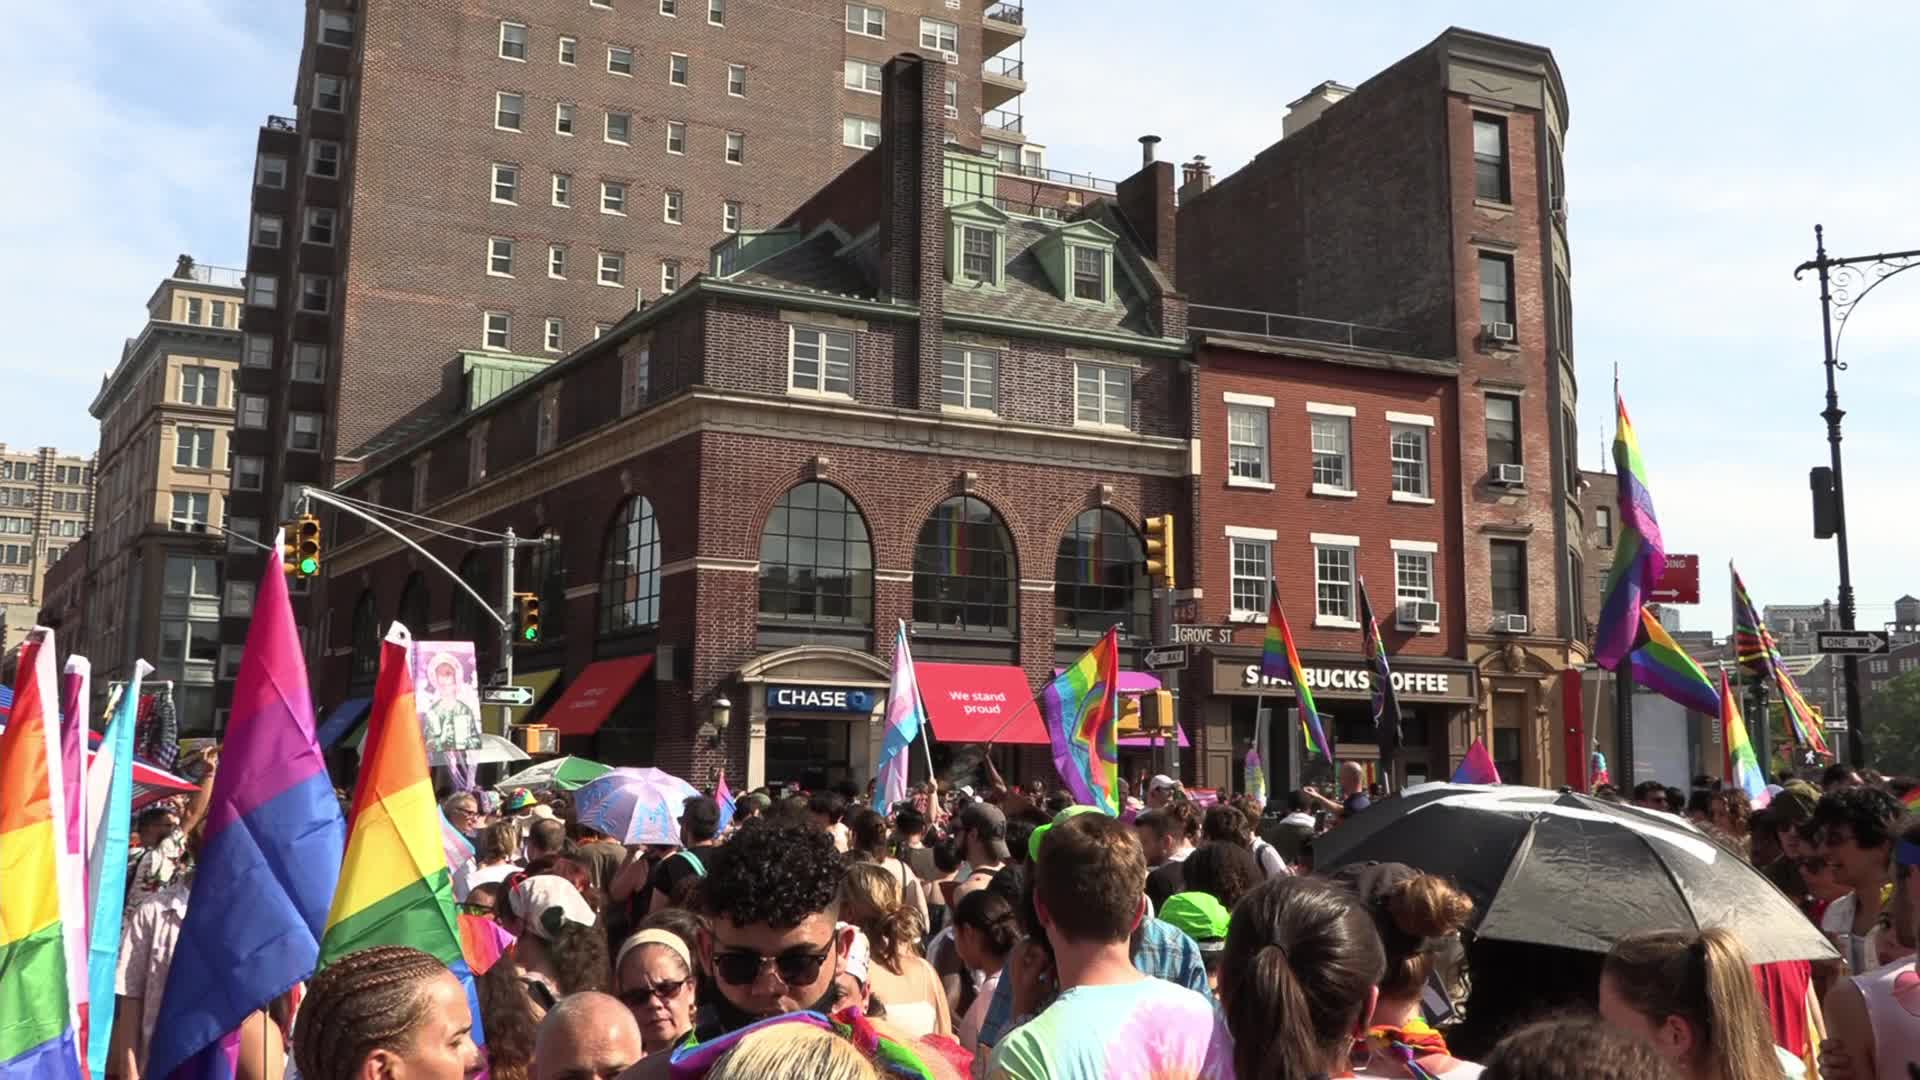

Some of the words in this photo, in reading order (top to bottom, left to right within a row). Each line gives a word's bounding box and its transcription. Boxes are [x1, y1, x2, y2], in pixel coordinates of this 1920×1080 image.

[1180, 628, 1213, 642] GROVE
[1219, 630, 1232, 643] ST
[1827, 639, 1848, 648] ONE
[1856, 639, 1877, 648] WAY
[1245, 664, 1369, 689] SBUCKS
[1389, 672, 1449, 692] OFFEE
[778, 689, 847, 707] CHASE
[949, 691, 969, 701] We
[971, 692, 1007, 702] stand
[963, 704, 1001, 715] proud
